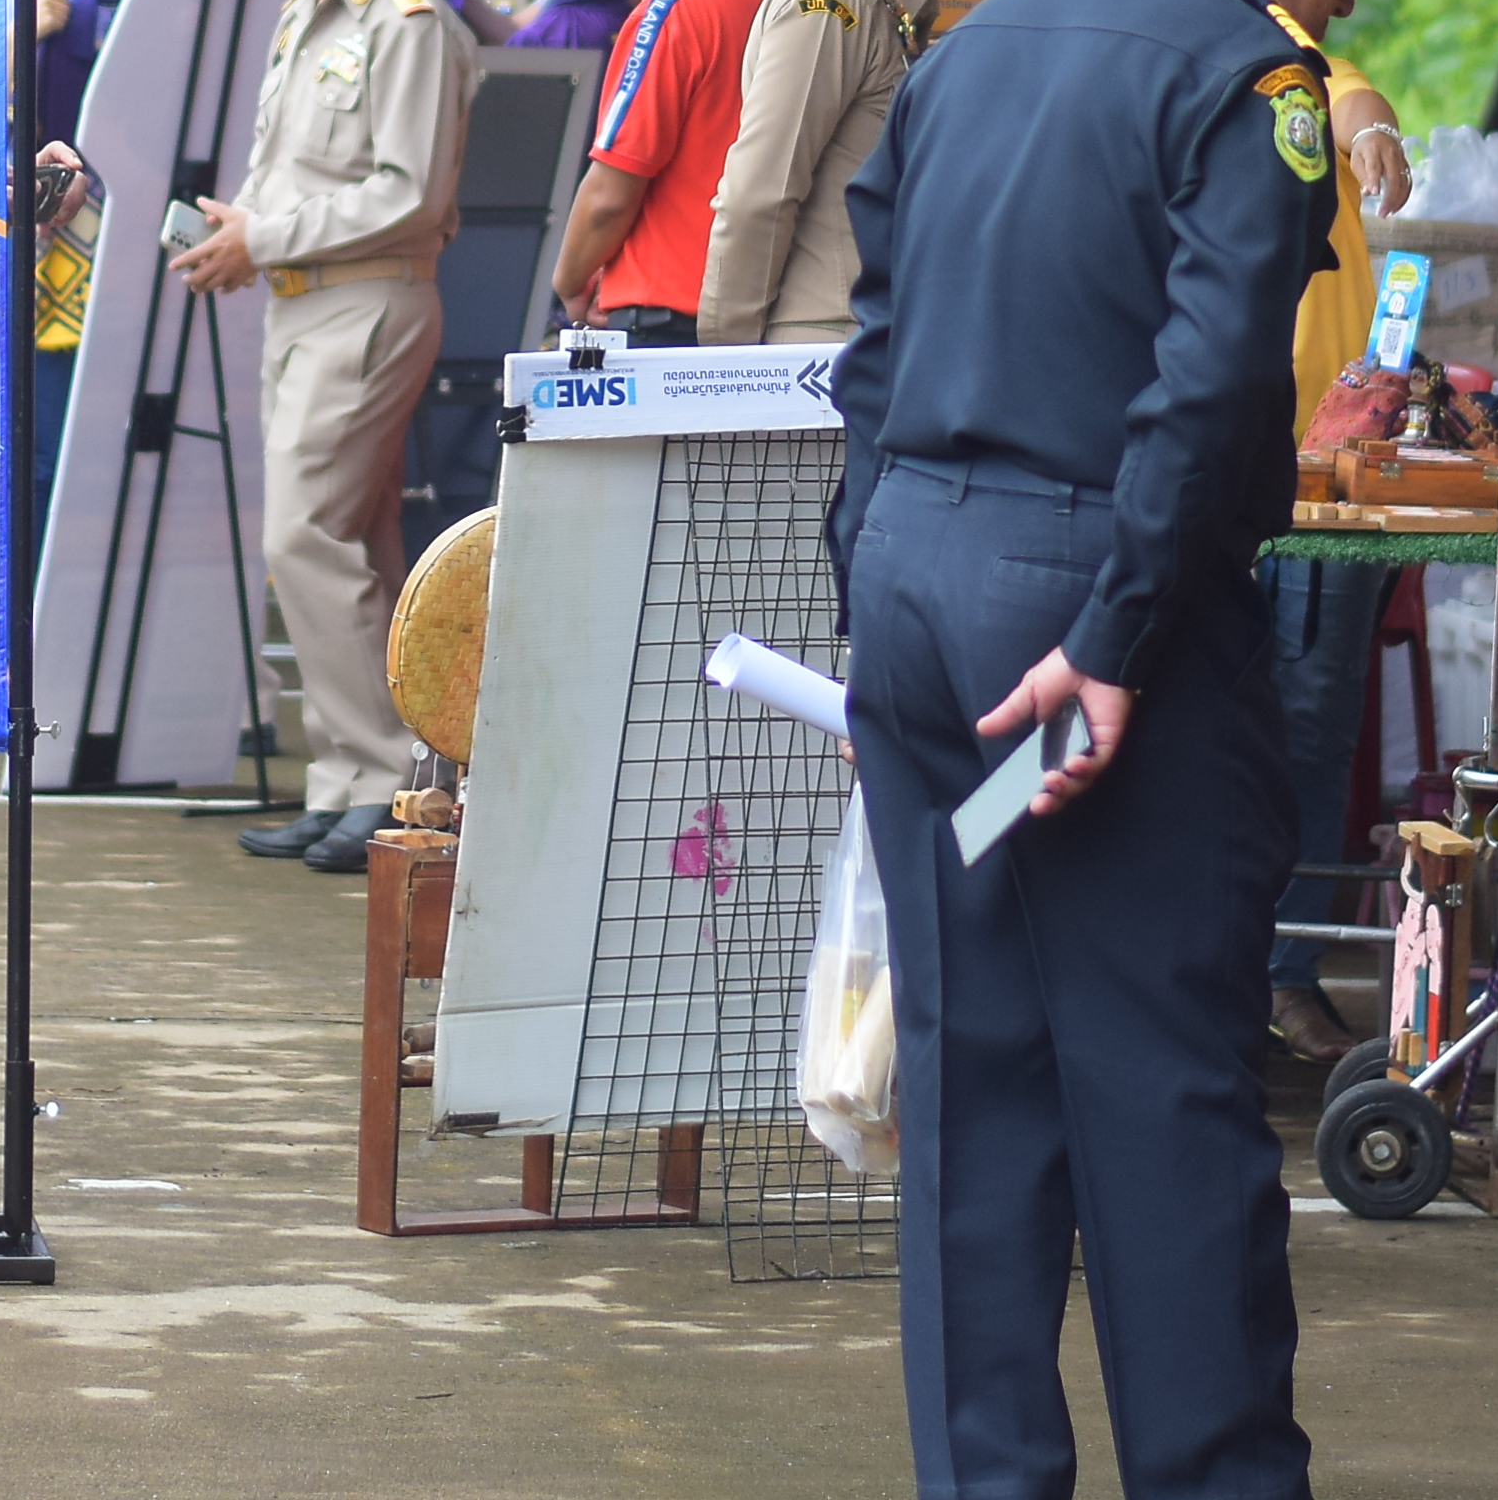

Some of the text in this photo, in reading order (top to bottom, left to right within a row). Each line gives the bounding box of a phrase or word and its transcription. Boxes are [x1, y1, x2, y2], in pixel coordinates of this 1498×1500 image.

[622, 47, 645, 91] POST
[662, 368, 790, 384] ขนาดกลางและขนาดย่อม
[532, 377, 637, 409] ISMED
[663, 382, 792, 398] สำนักงานส่งเสริมวิสาหกิจ
